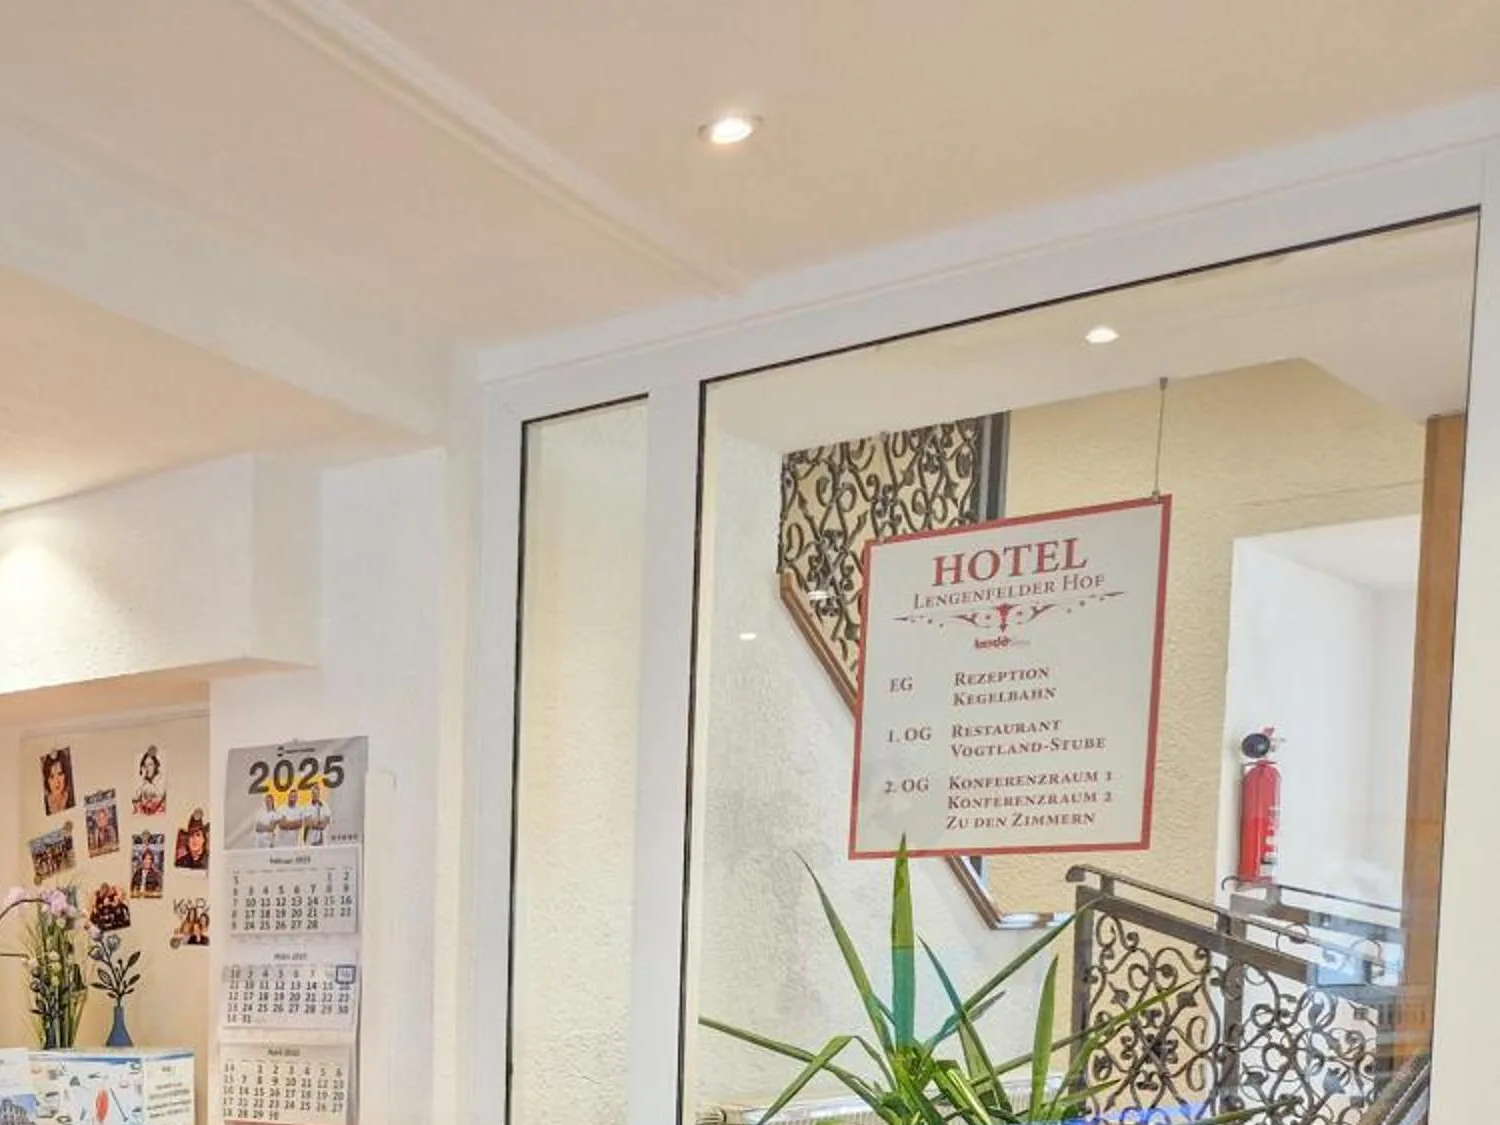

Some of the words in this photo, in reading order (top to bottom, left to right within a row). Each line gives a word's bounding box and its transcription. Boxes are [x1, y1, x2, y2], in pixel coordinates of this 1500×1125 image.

[932, 538, 1088, 586] HOTEL
[914, 581, 1055, 609] LENGENFELDER
[1062, 574, 1105, 592] HOF
[889, 677, 913, 692] EG
[954, 667, 1050, 687] REZEPTION
[953, 687, 1057, 707] KEGELBAHN
[887, 729, 900, 743] 1.
[905, 726, 932, 741] OG
[951, 719, 1062, 738] RESTAURANT
[950, 736, 1107, 758] VOGTLAND-STUBE
[248, 755, 345, 795] 2025
[884, 781, 897, 793] 2.
[902, 777, 929, 793] OG
[949, 771, 1098, 790] KONFERENZRAUM
[948, 792, 1097, 809] KONFERENZRAUM
[1104, 792, 1112, 803] 2
[946, 815, 969, 830] ZU
[973, 816, 1006, 829] DEN
[1011, 812, 1096, 827] ZIMMERN
